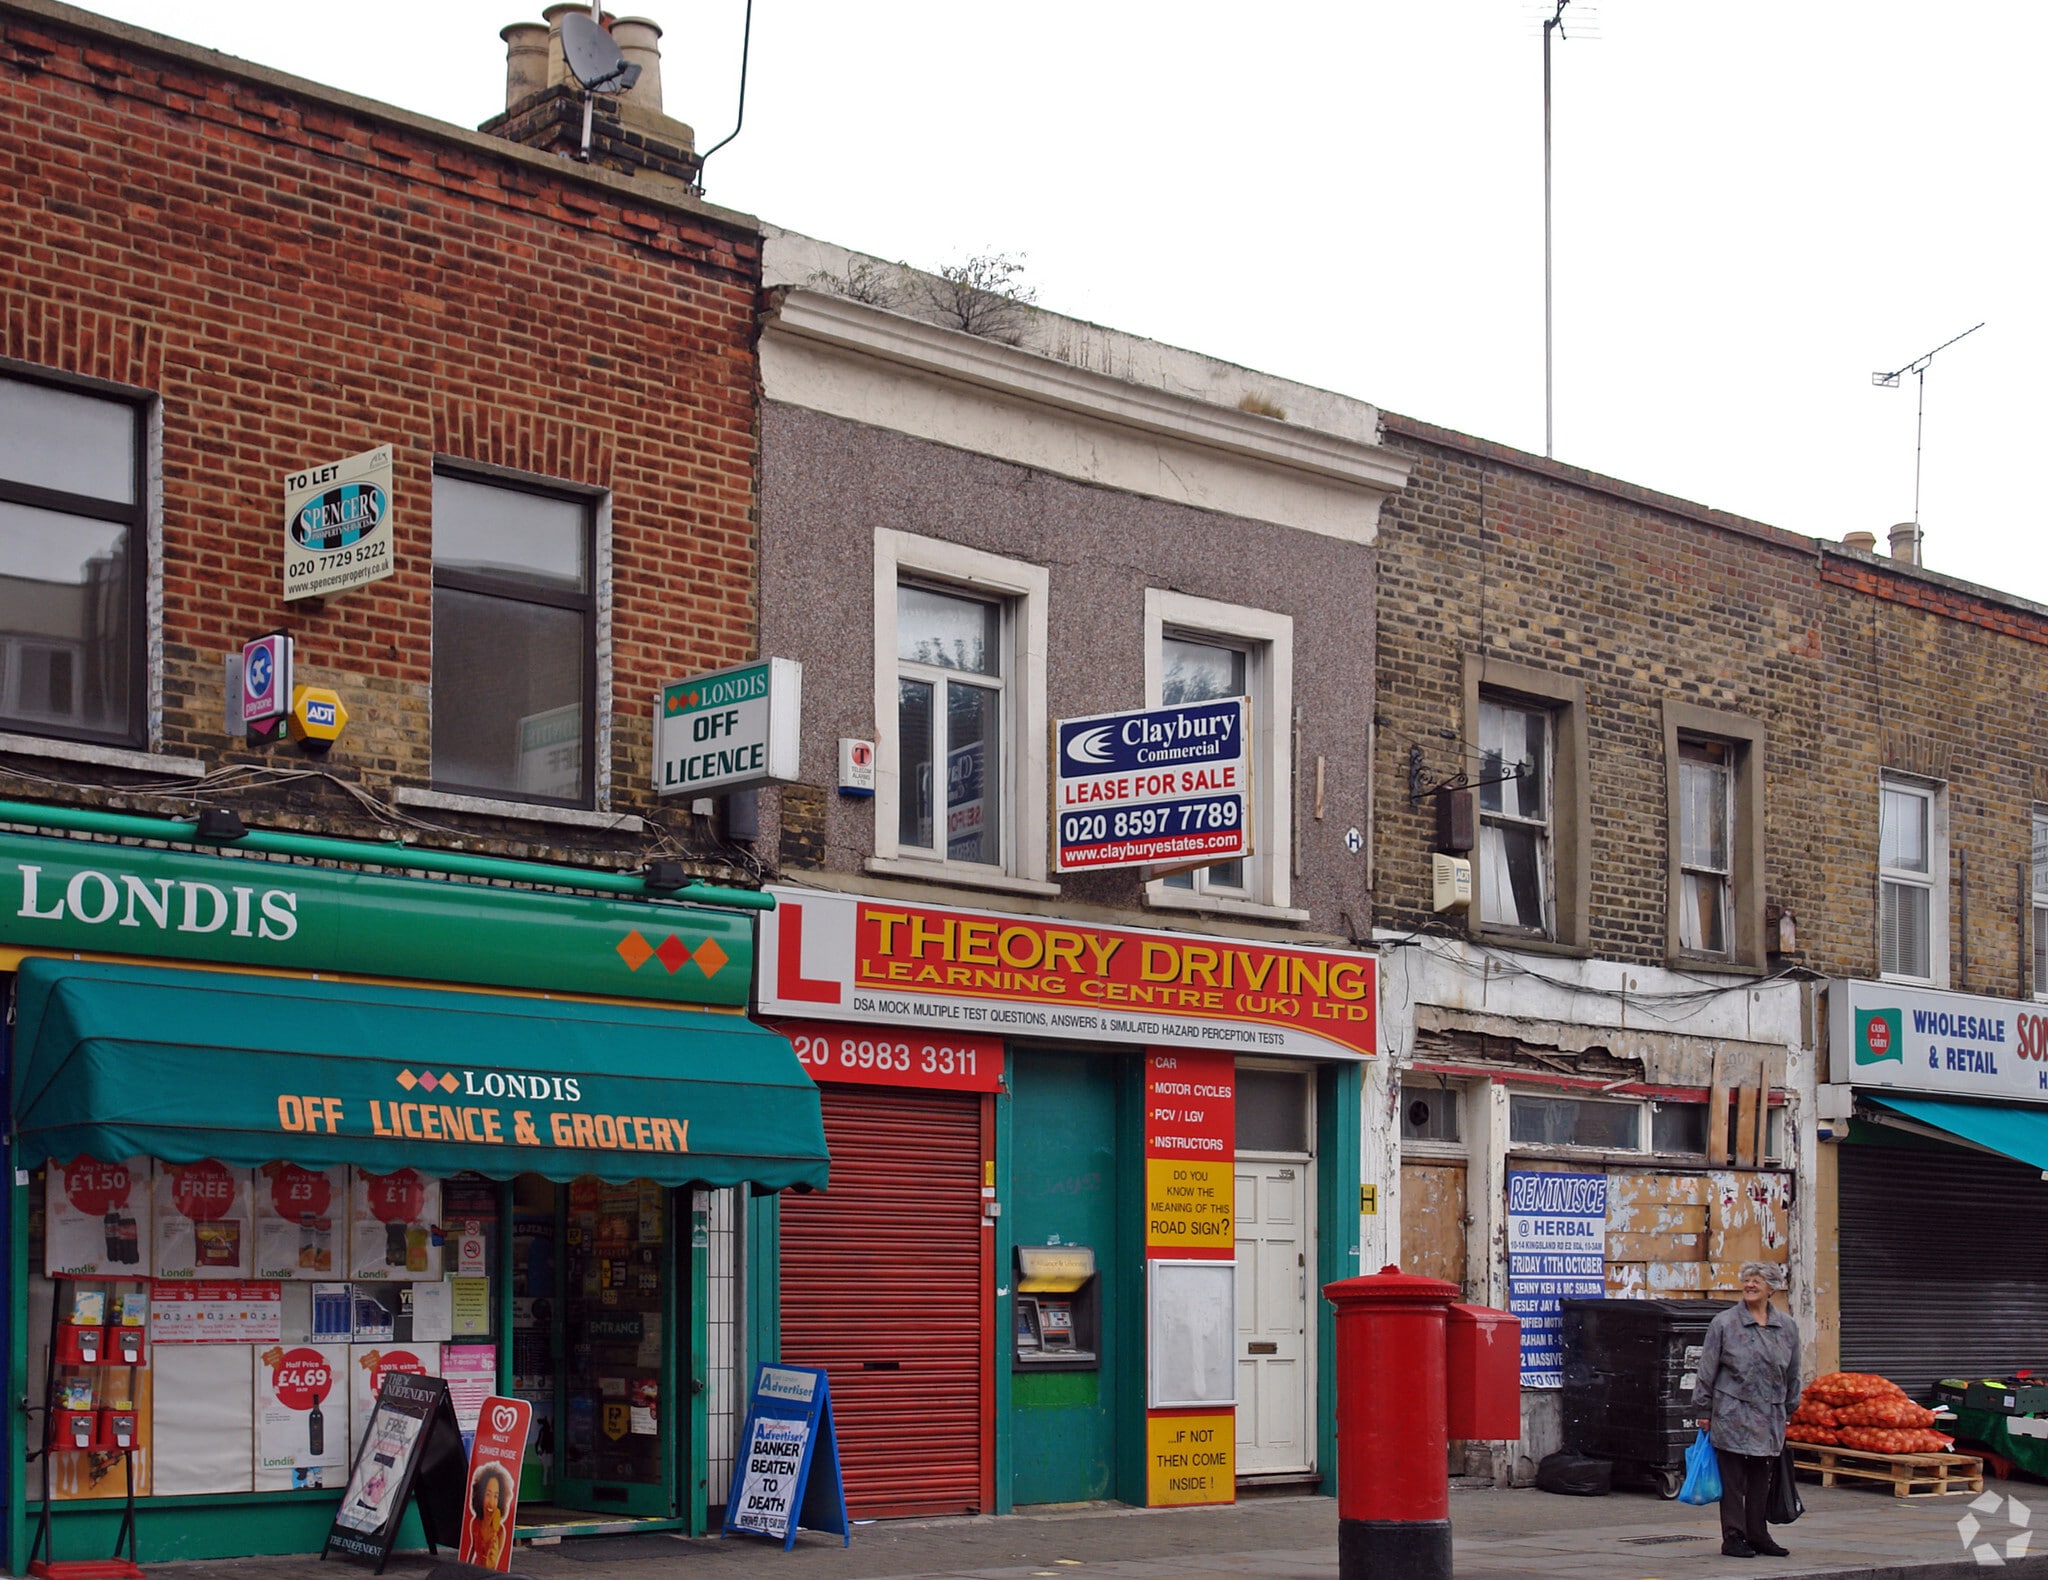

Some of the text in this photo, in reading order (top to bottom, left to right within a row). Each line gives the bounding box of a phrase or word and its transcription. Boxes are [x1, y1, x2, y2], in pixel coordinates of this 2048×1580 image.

[288, 465, 339, 491] TO LET
[300, 490, 379, 543] SPENCERS
[312, 525, 343, 541] PROPERTY
[289, 541, 385, 577] 020 7729 5222
[288, 559, 389, 595] www.spencersproperty.co.uk
[701, 673, 766, 707] LONDIS
[246, 698, 272, 717] payzone
[307, 705, 335, 721] ADT
[693, 710, 739, 742] OFF
[1121, 714, 1236, 748] Claybury
[1137, 740, 1220, 763] Commercial
[665, 743, 764, 786] LICENCE
[1065, 766, 1236, 805] LEASE FOR SALE
[1065, 801, 1238, 842] 020 8597 7789
[1065, 834, 1238, 862] www.clayburyestates.com
[1349, 832, 1360, 848] H
[17, 863, 298, 941] LONDIS
[777, 903, 843, 1006] L
[865, 909, 1367, 1001] THEORY DRIVING
[861, 959, 1369, 1022] LEARNING CENTRE (UK) LTD
[854, 998, 1285, 1046] DSA MOCK MULTIPLE TEST QUESTIONS, ANSWERS & SIMULATED HAZARD PERCEPTION TESTS
[1871, 1024, 1885, 1033] CASH
[1913, 1009, 2006, 1043] WHOLESALE
[1870, 1038, 1887, 1048] CARRY
[793, 1036, 977, 1076] 20 8983 3311
[1155, 1056, 1177, 1069] CAR
[1928, 1045, 1998, 1075] & RETAIL
[463, 1071, 581, 1102] LONDIS
[1155, 1082, 1232, 1099] MOTOR CYCLES
[277, 1094, 690, 1153] OFF LICENCE & GROCERY
[1155, 1108, 1175, 1121] PCV
[1184, 1110, 1204, 1123] LGV
[1155, 1136, 1223, 1151] INSTRUCTORS
[71, 1172, 126, 1191] £1.50
[1173, 1170, 1208, 1181] DO YOU
[180, 1180, 229, 1198] FREE
[290, 1183, 313, 1200] £3
[1167, 1186, 1214, 1198] KNOW THE
[1510, 1176, 1607, 1213] REMINISCE
[1151, 1202, 1229, 1214] MEANING OF THIS
[1361, 1187, 1374, 1212] H
[1151, 1218, 1229, 1236] ROAD SIGN?
[1518, 1220, 1594, 1237] @ HERBAL
[161, 1268, 194, 1277] Londis
[261, 1268, 292, 1278] Londis
[1511, 1256, 1603, 1274] FRIDAY 17TH OCTOBER
[358, 1269, 388, 1279] Londis
[1514, 1282, 1539, 1294] KENNY
[1541, 1282, 1555, 1294] KEN
[1556, 1282, 1562, 1294] &
[1575, 1282, 1602, 1294] SHABBA
[1510, 1300, 1560, 1312] WESLEY JAY &
[590, 1321, 640, 1335] ENTRANCE
[1521, 1317, 1543, 1329] DIFIED
[1520, 1335, 1553, 1346] RAHAM R
[286, 1360, 320, 1369] Half Price
[400, 1363, 418, 1371] extra
[1527, 1352, 1563, 1367] MASSIVE
[278, 1369, 327, 1388] £4.69
[760, 1373, 813, 1396] Advertiser
[384, 1384, 436, 1403] INDEPENDENT
[385, 1417, 409, 1434] FREE
[755, 1423, 804, 1442] Advertiser
[1190, 1430, 1214, 1442] NOT
[754, 1441, 800, 1458] BANKER
[263, 1457, 295, 1467] Londis
[751, 1459, 795, 1475] BEATEN
[1157, 1453, 1226, 1467] THEN COME
[763, 1479, 778, 1493] TO
[1169, 1477, 1206, 1491] INSIDE
[747, 1496, 786, 1512] DEATH
[341, 1538, 383, 1557] INDEPENDENT
